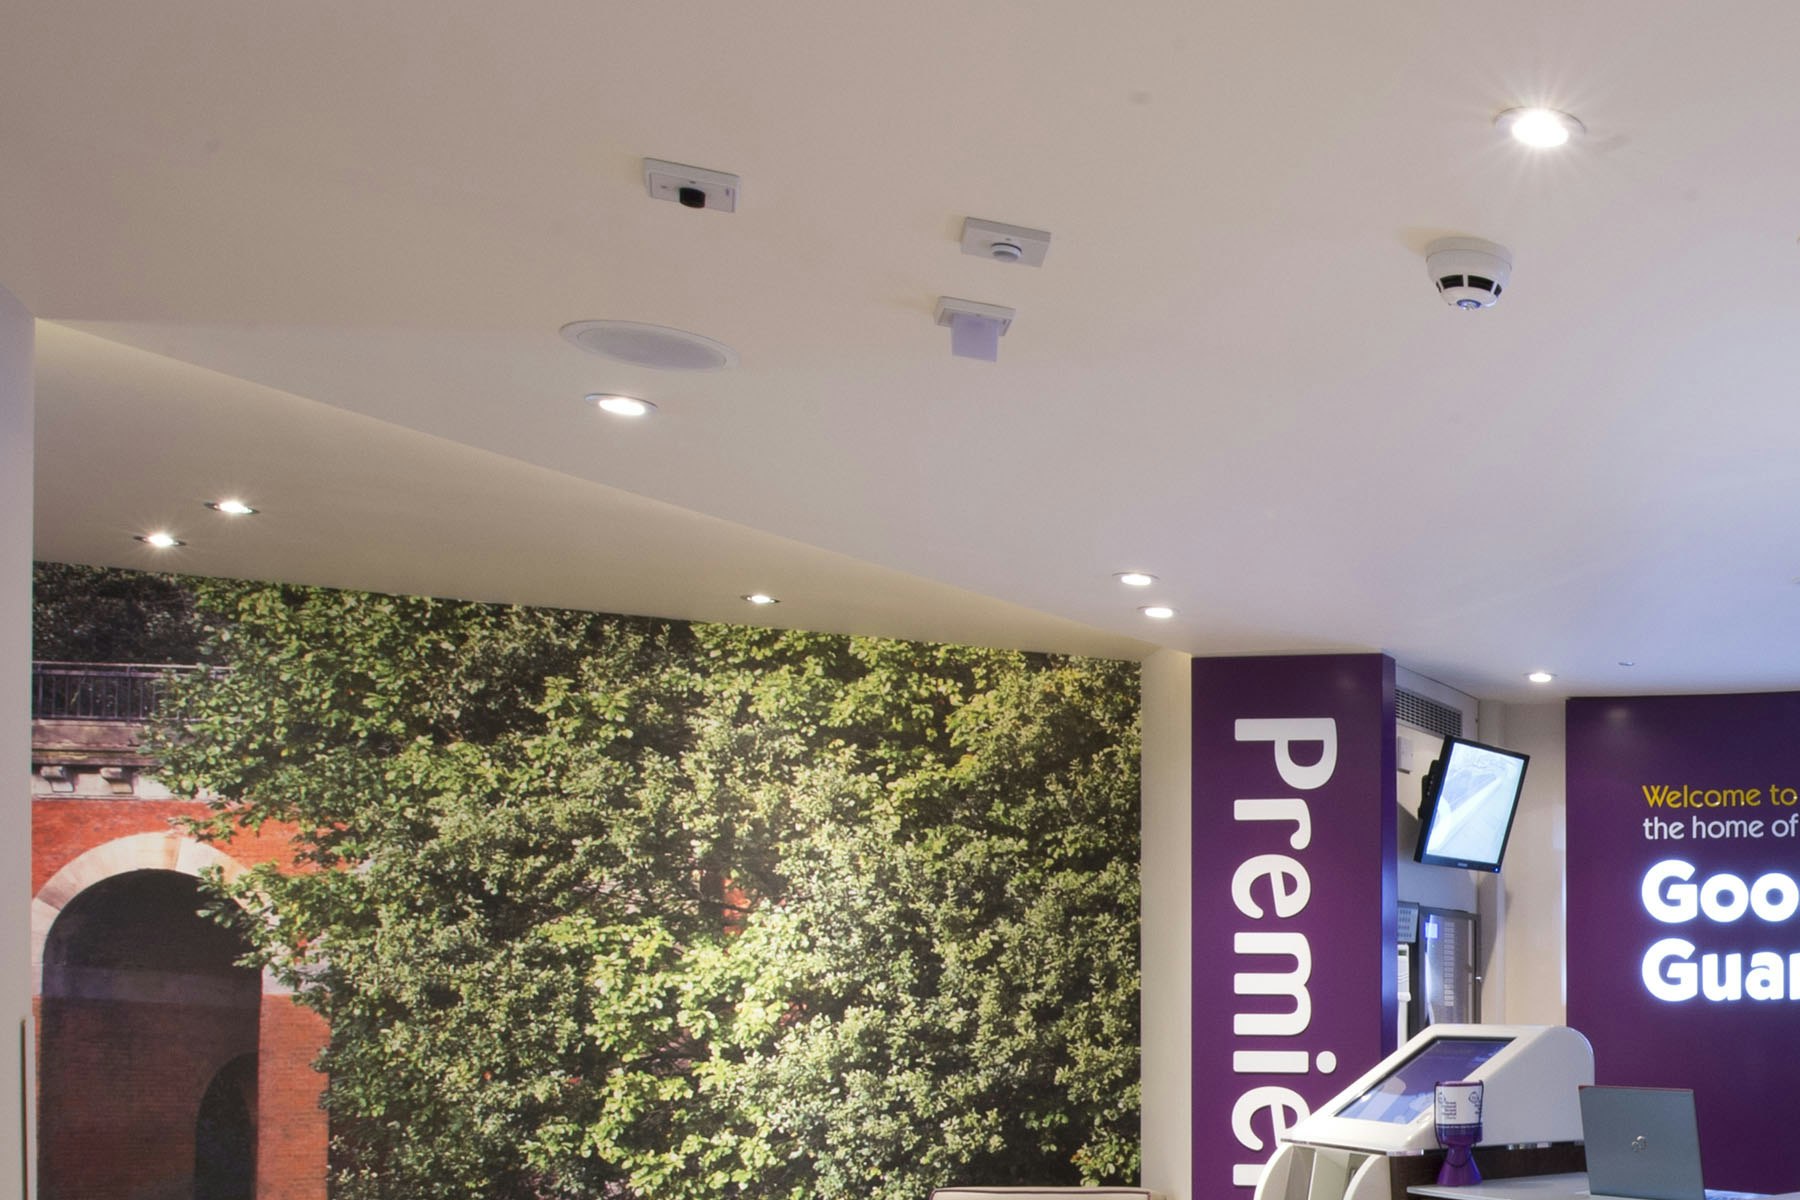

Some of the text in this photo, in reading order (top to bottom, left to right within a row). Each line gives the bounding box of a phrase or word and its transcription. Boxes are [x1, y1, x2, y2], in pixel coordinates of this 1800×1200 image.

[1641, 784, 1799, 809] Welcome to
[1642, 815, 1685, 840] the
[1691, 815, 1765, 840] home
[1771, 813, 1800, 838] of
[1231, 717, 1338, 1186] Premie
